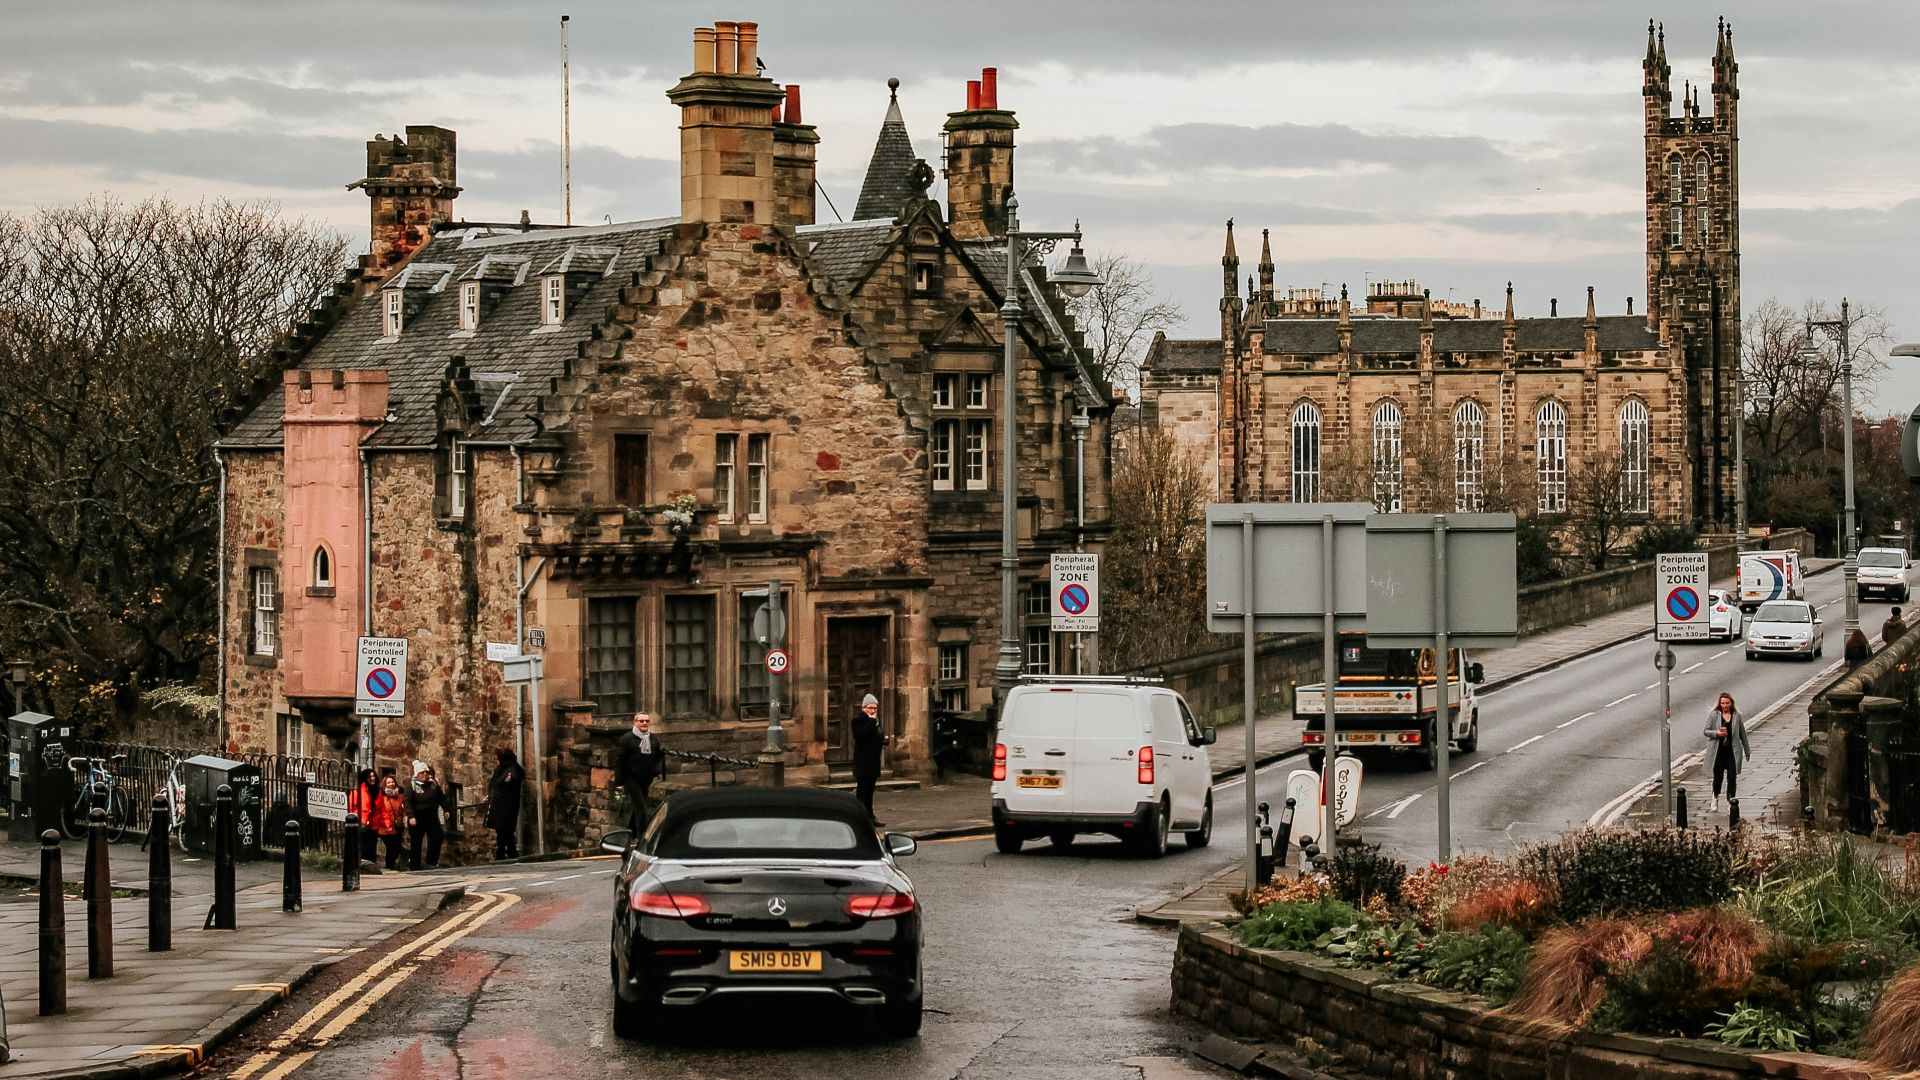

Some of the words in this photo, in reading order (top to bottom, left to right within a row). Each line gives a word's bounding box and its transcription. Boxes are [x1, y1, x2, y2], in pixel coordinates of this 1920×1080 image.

[1661, 556, 1704, 564] Peripheral
[1060, 573, 1088, 582] ZONE
[1667, 575, 1698, 584] ZONE
[368, 657, 396, 665] ZONE
[770, 657, 785, 666] 20
[309, 789, 329, 803] BELFORD
[331, 793, 345, 805] ROAD
[740, 952, 776, 967] SM19
[781, 952, 812, 967] OBV
